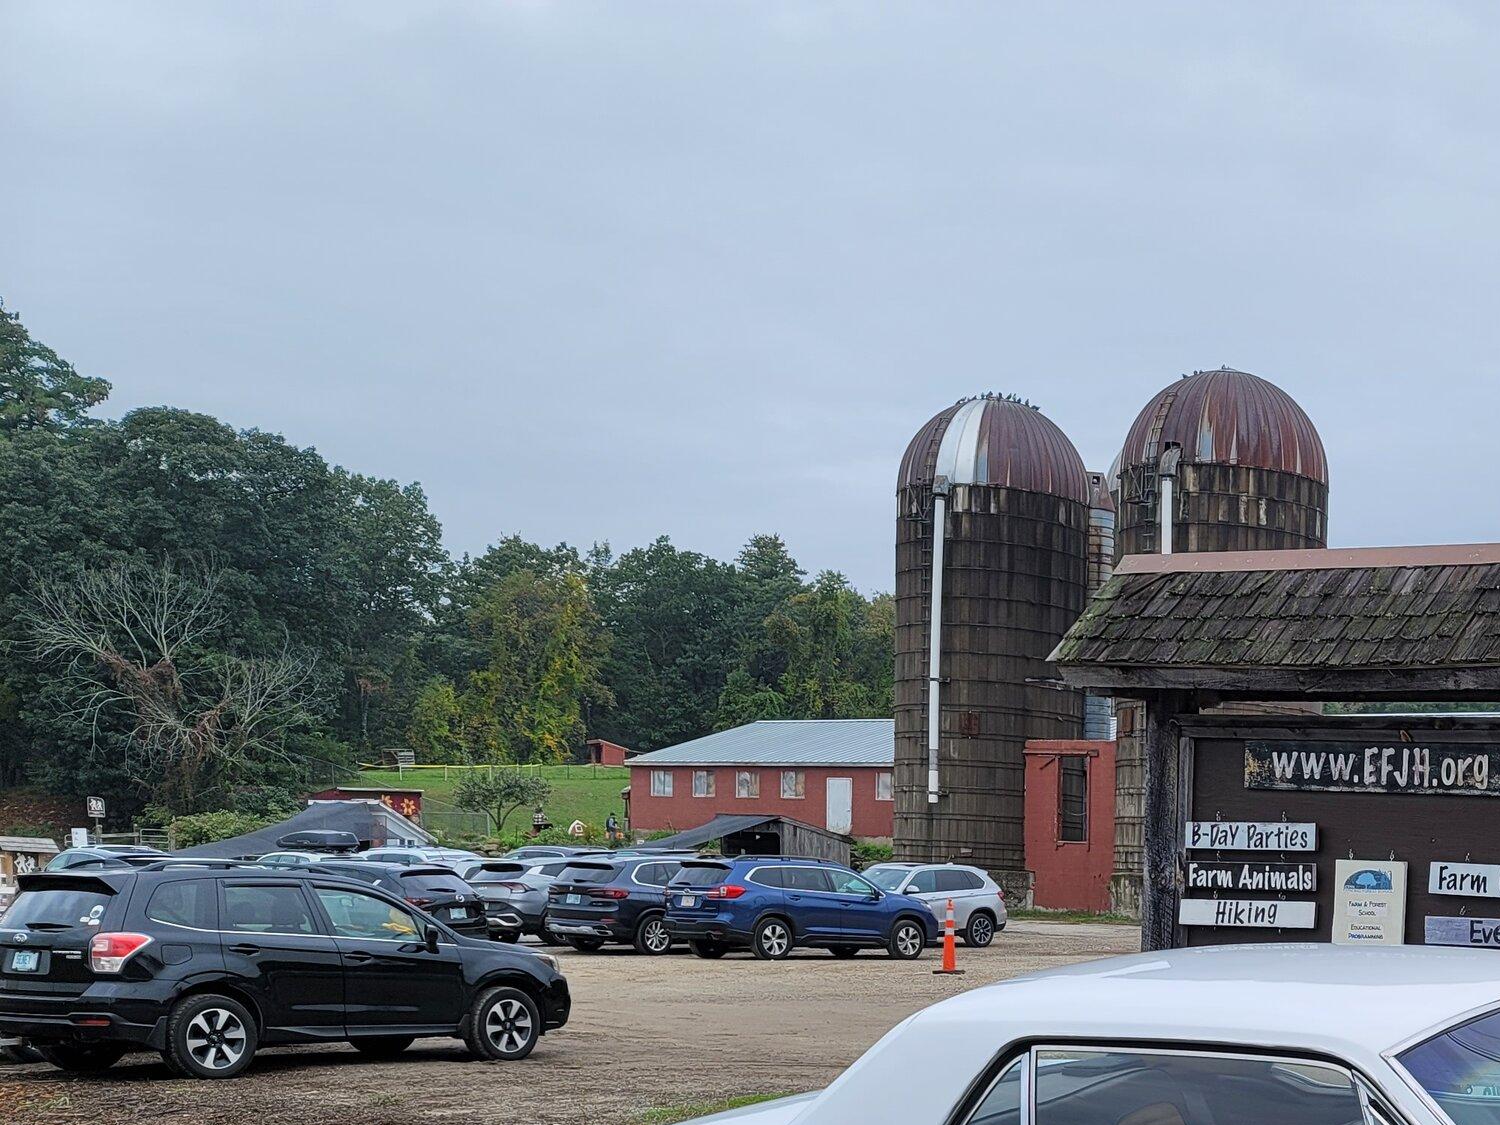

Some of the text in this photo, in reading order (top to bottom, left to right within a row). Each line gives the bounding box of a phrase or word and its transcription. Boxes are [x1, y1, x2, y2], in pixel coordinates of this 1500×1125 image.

[1271, 747, 1489, 789] www.EFJH.org
[1246, 824, 1308, 848] Parties
[1188, 863, 1312, 890] Farm Animals
[1438, 865, 1488, 893] Farm
[1215, 901, 1278, 924] Hiking
